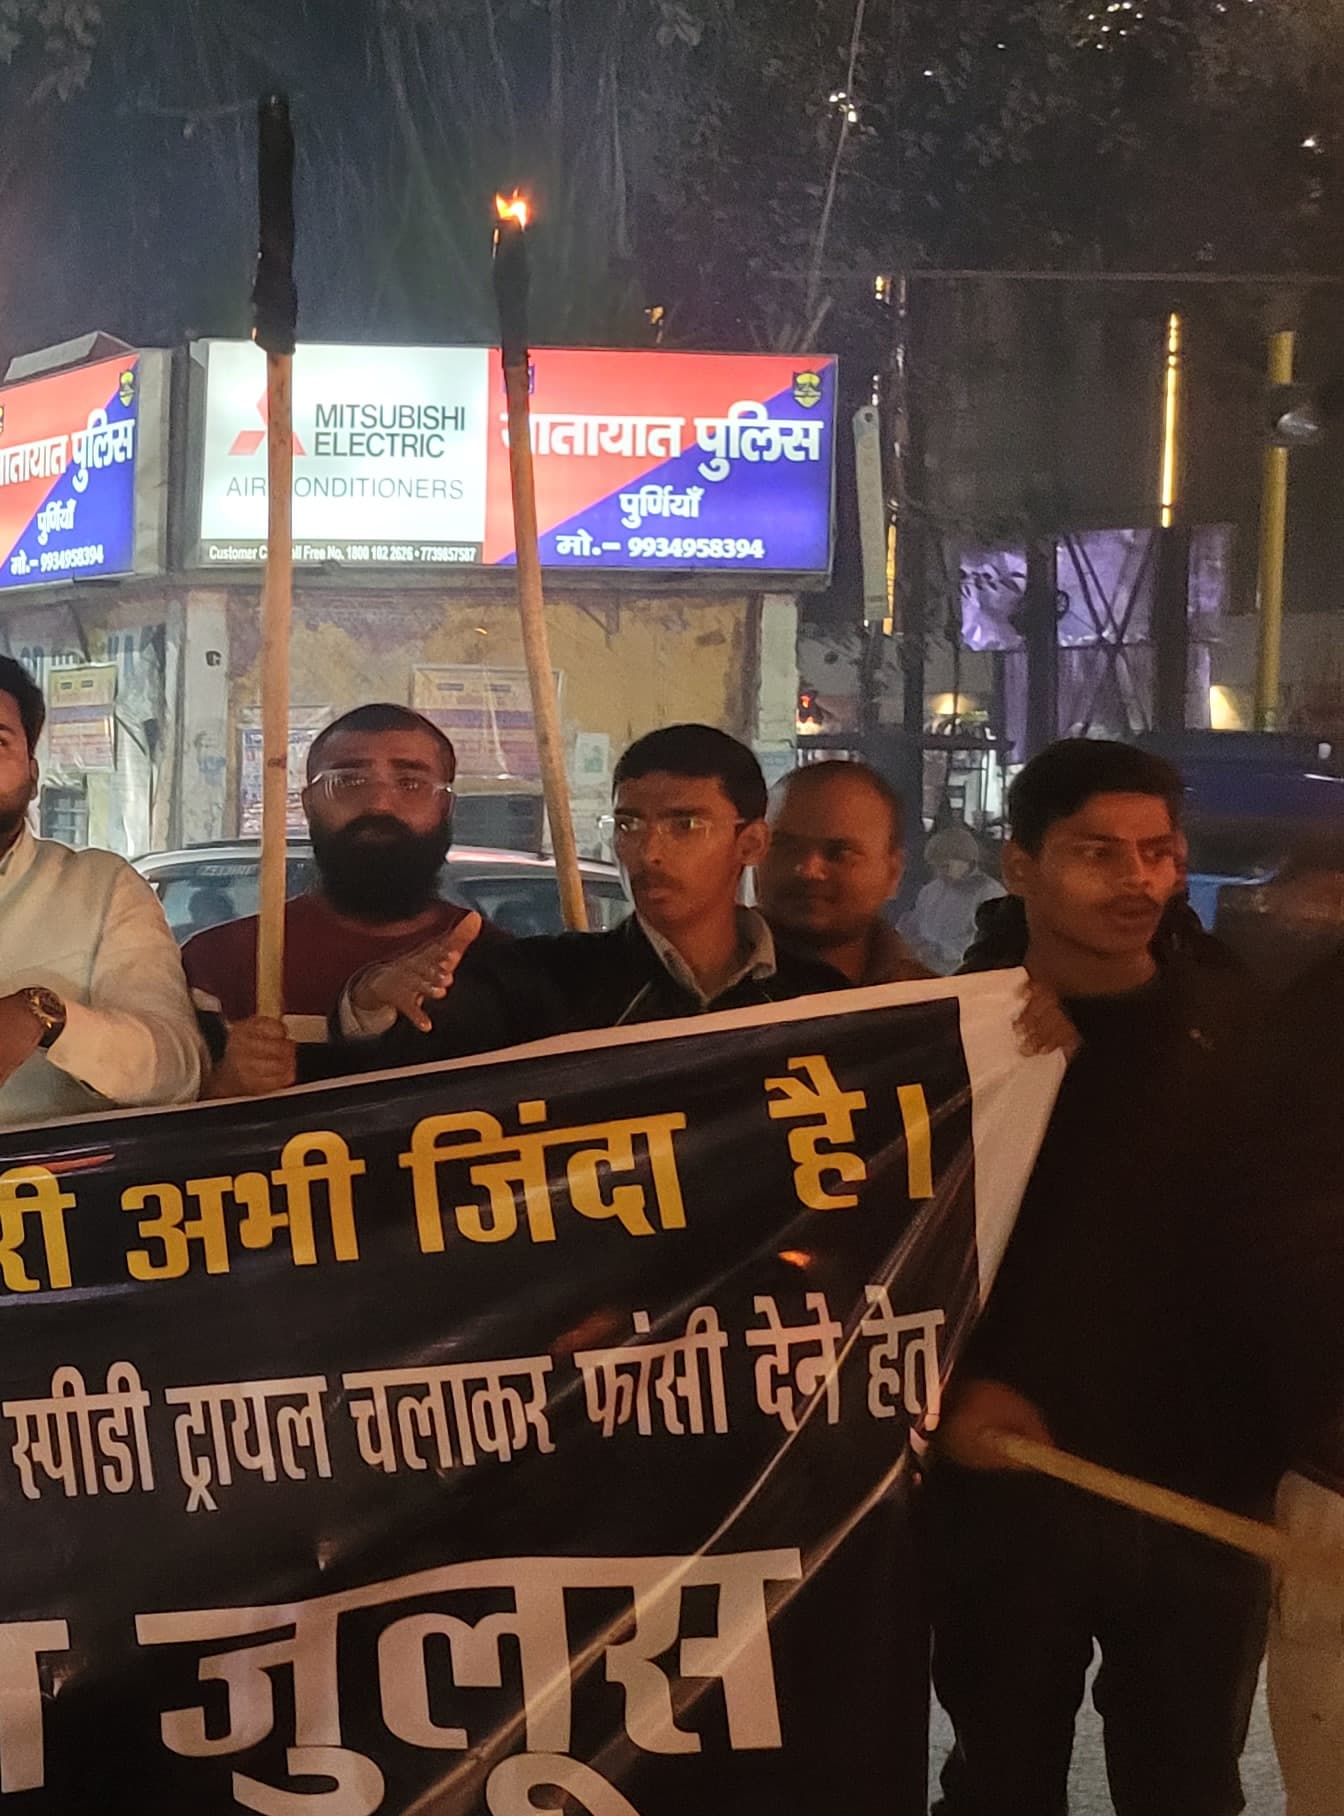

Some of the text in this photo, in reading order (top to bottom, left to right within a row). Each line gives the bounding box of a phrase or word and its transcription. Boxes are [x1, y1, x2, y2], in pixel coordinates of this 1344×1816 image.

[315, 404, 465, 431] MITSUBISHI
[695, 401, 823, 482] पुलिस
[70, 408, 136, 493] पुलिस
[314, 433, 445, 458] ELECTRIC
[293, 477, 464, 500] ONDITIONERS
[209, 545, 258, 560] Customer
[303, 545, 326, 560] Free
[627, 537, 765, 559] 9934958394
[121, 1131, 366, 1281] अभी
[400, 1100, 688, 1252] जिंदा
[3, 1361, 155, 1500] स्पीडी
[165, 1375, 333, 1513] ट्रायल
[342, 1355, 556, 1474] चलाकर
[573, 1306, 729, 1437] फांसी
[745, 1292, 843, 1432] देने
[135, 1548, 802, 1816] जुलूस
